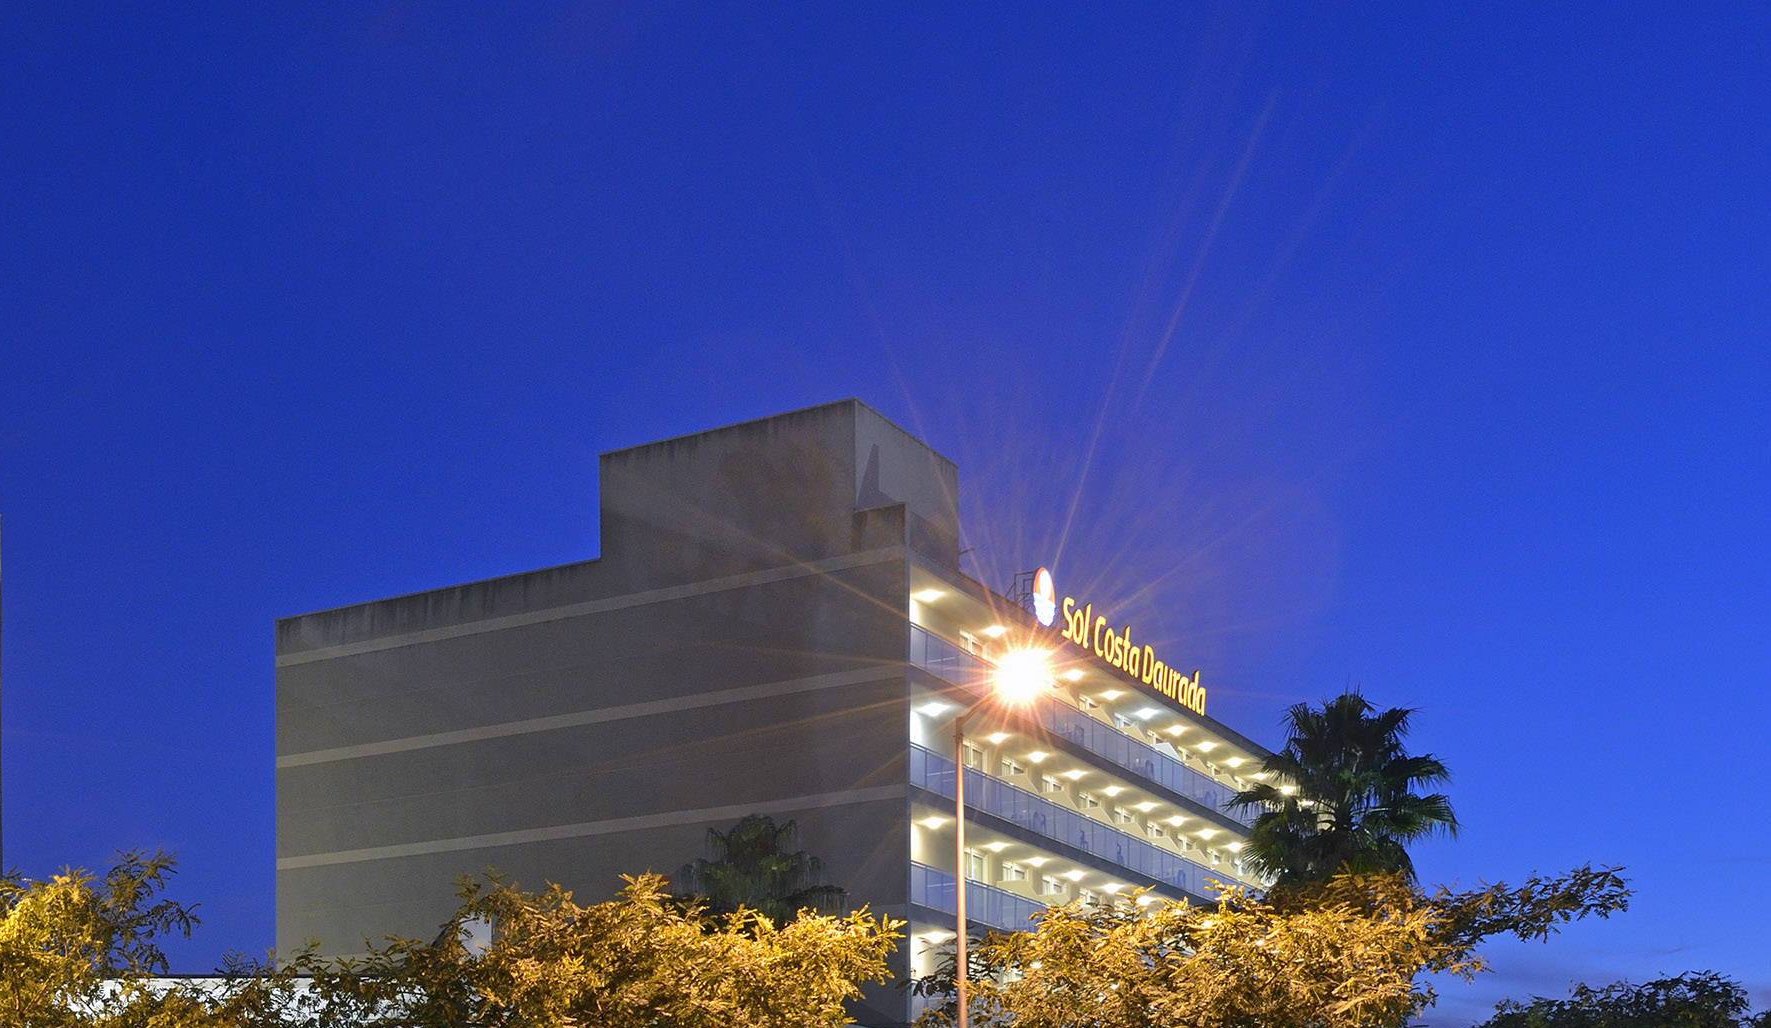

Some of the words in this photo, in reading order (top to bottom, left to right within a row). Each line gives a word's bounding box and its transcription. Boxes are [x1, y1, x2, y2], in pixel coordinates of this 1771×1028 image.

[1061, 596, 1092, 649] Sol
[1093, 615, 1141, 678] Costa
[1141, 644, 1207, 717] Daurada
